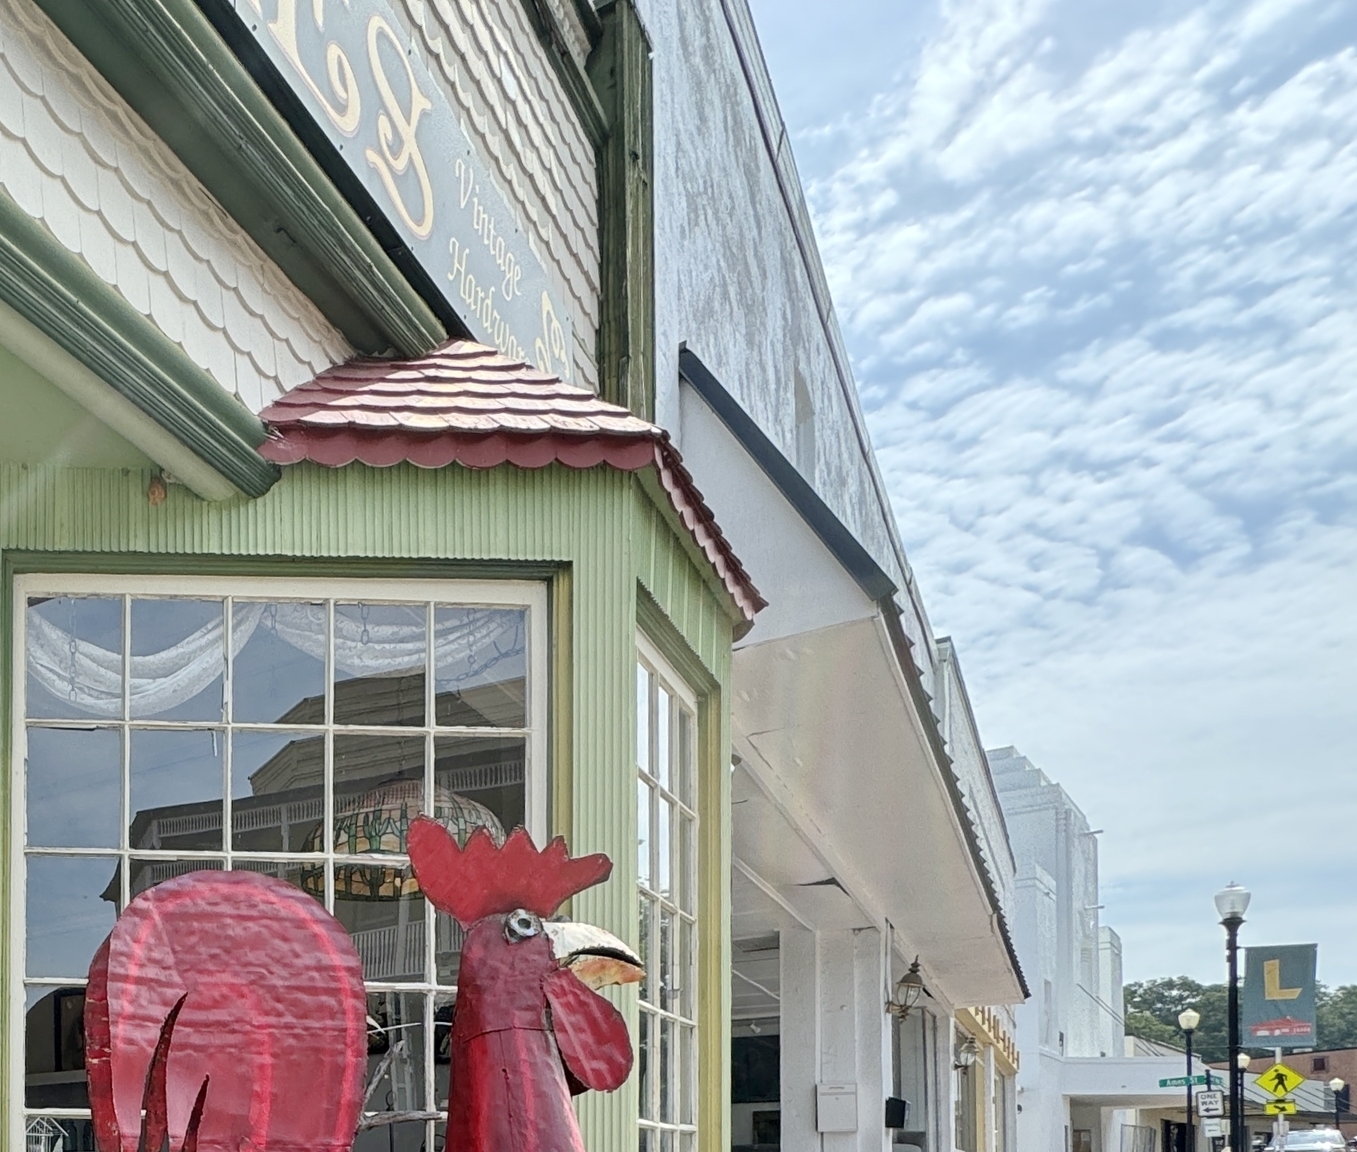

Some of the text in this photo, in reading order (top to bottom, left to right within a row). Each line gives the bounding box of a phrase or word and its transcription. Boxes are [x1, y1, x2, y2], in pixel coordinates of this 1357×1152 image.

[454, 157, 522, 303] Vintage
[1263, 959, 1303, 1000] L
[1166, 1076, 1198, 1087] Ames St
[1200, 1099, 1219, 1107] WAY
